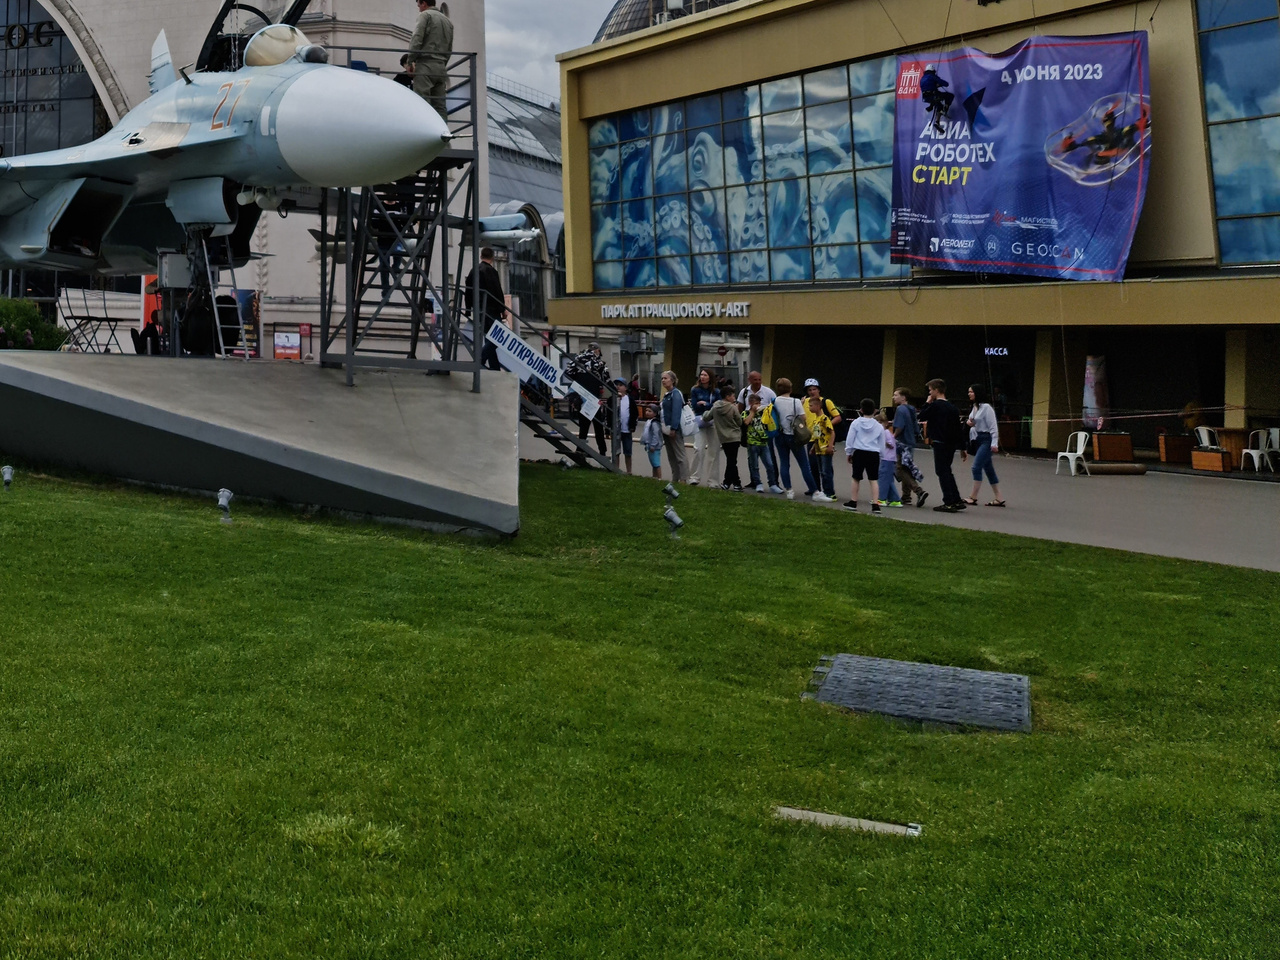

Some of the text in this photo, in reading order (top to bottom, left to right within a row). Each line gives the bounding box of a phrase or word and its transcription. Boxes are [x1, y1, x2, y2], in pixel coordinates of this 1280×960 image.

[1001, 70, 1012, 85] 4
[1064, 63, 1103, 80] 2023
[210, 77, 254, 131] 27
[919, 120, 971, 139] АВИА
[915, 142, 996, 162] РОБОТЕХ
[912, 165, 972, 185] СТАРТ
[1011, 241, 1084, 259] GEOSCAN
[601, 301, 750, 321] ПАРК АТТРАКЦИОНОВ V-ART
[490, 324, 558, 384] МЫ ОТКРЫЛИСЬ
[984, 347, 1009, 356] КАССА
